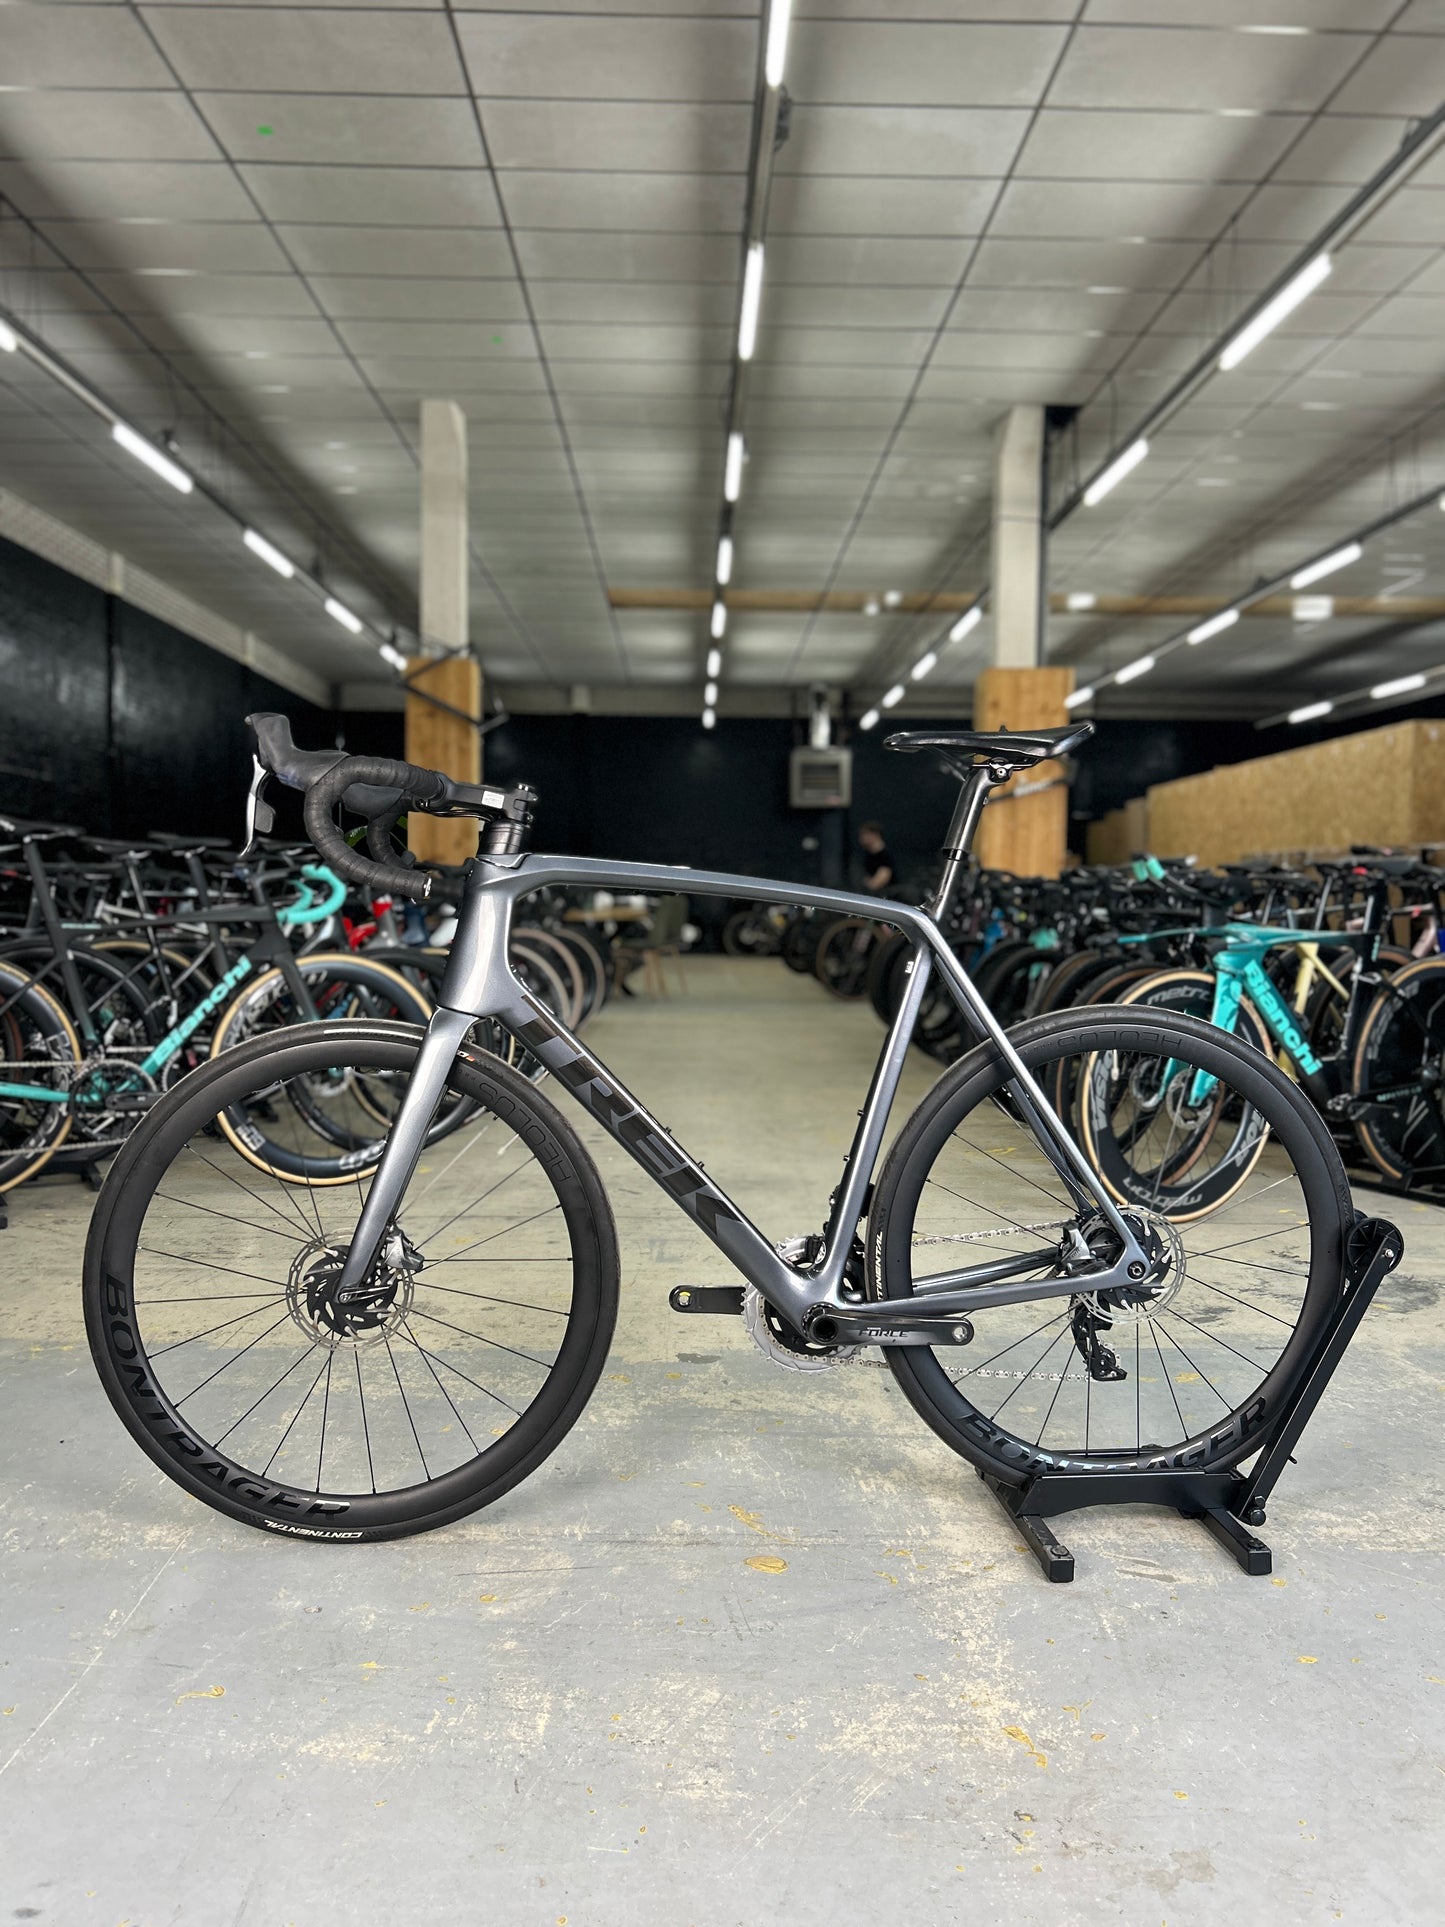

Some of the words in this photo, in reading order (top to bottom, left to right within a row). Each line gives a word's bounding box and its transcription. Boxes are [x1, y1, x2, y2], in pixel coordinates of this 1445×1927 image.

[152, 954, 252, 1068] Bianchi
[1147, 985, 1210, 1005] metr
[1244, 959, 1324, 1076] Bianchi
[517, 994, 744, 1235] TREK
[875, 1231, 883, 1301] TINENTAL
[858, 1329, 909, 1338] FORCE
[106, 1273, 351, 1521] BONTRAGER
[264, 1519, 363, 1539] CONTINENTAL
